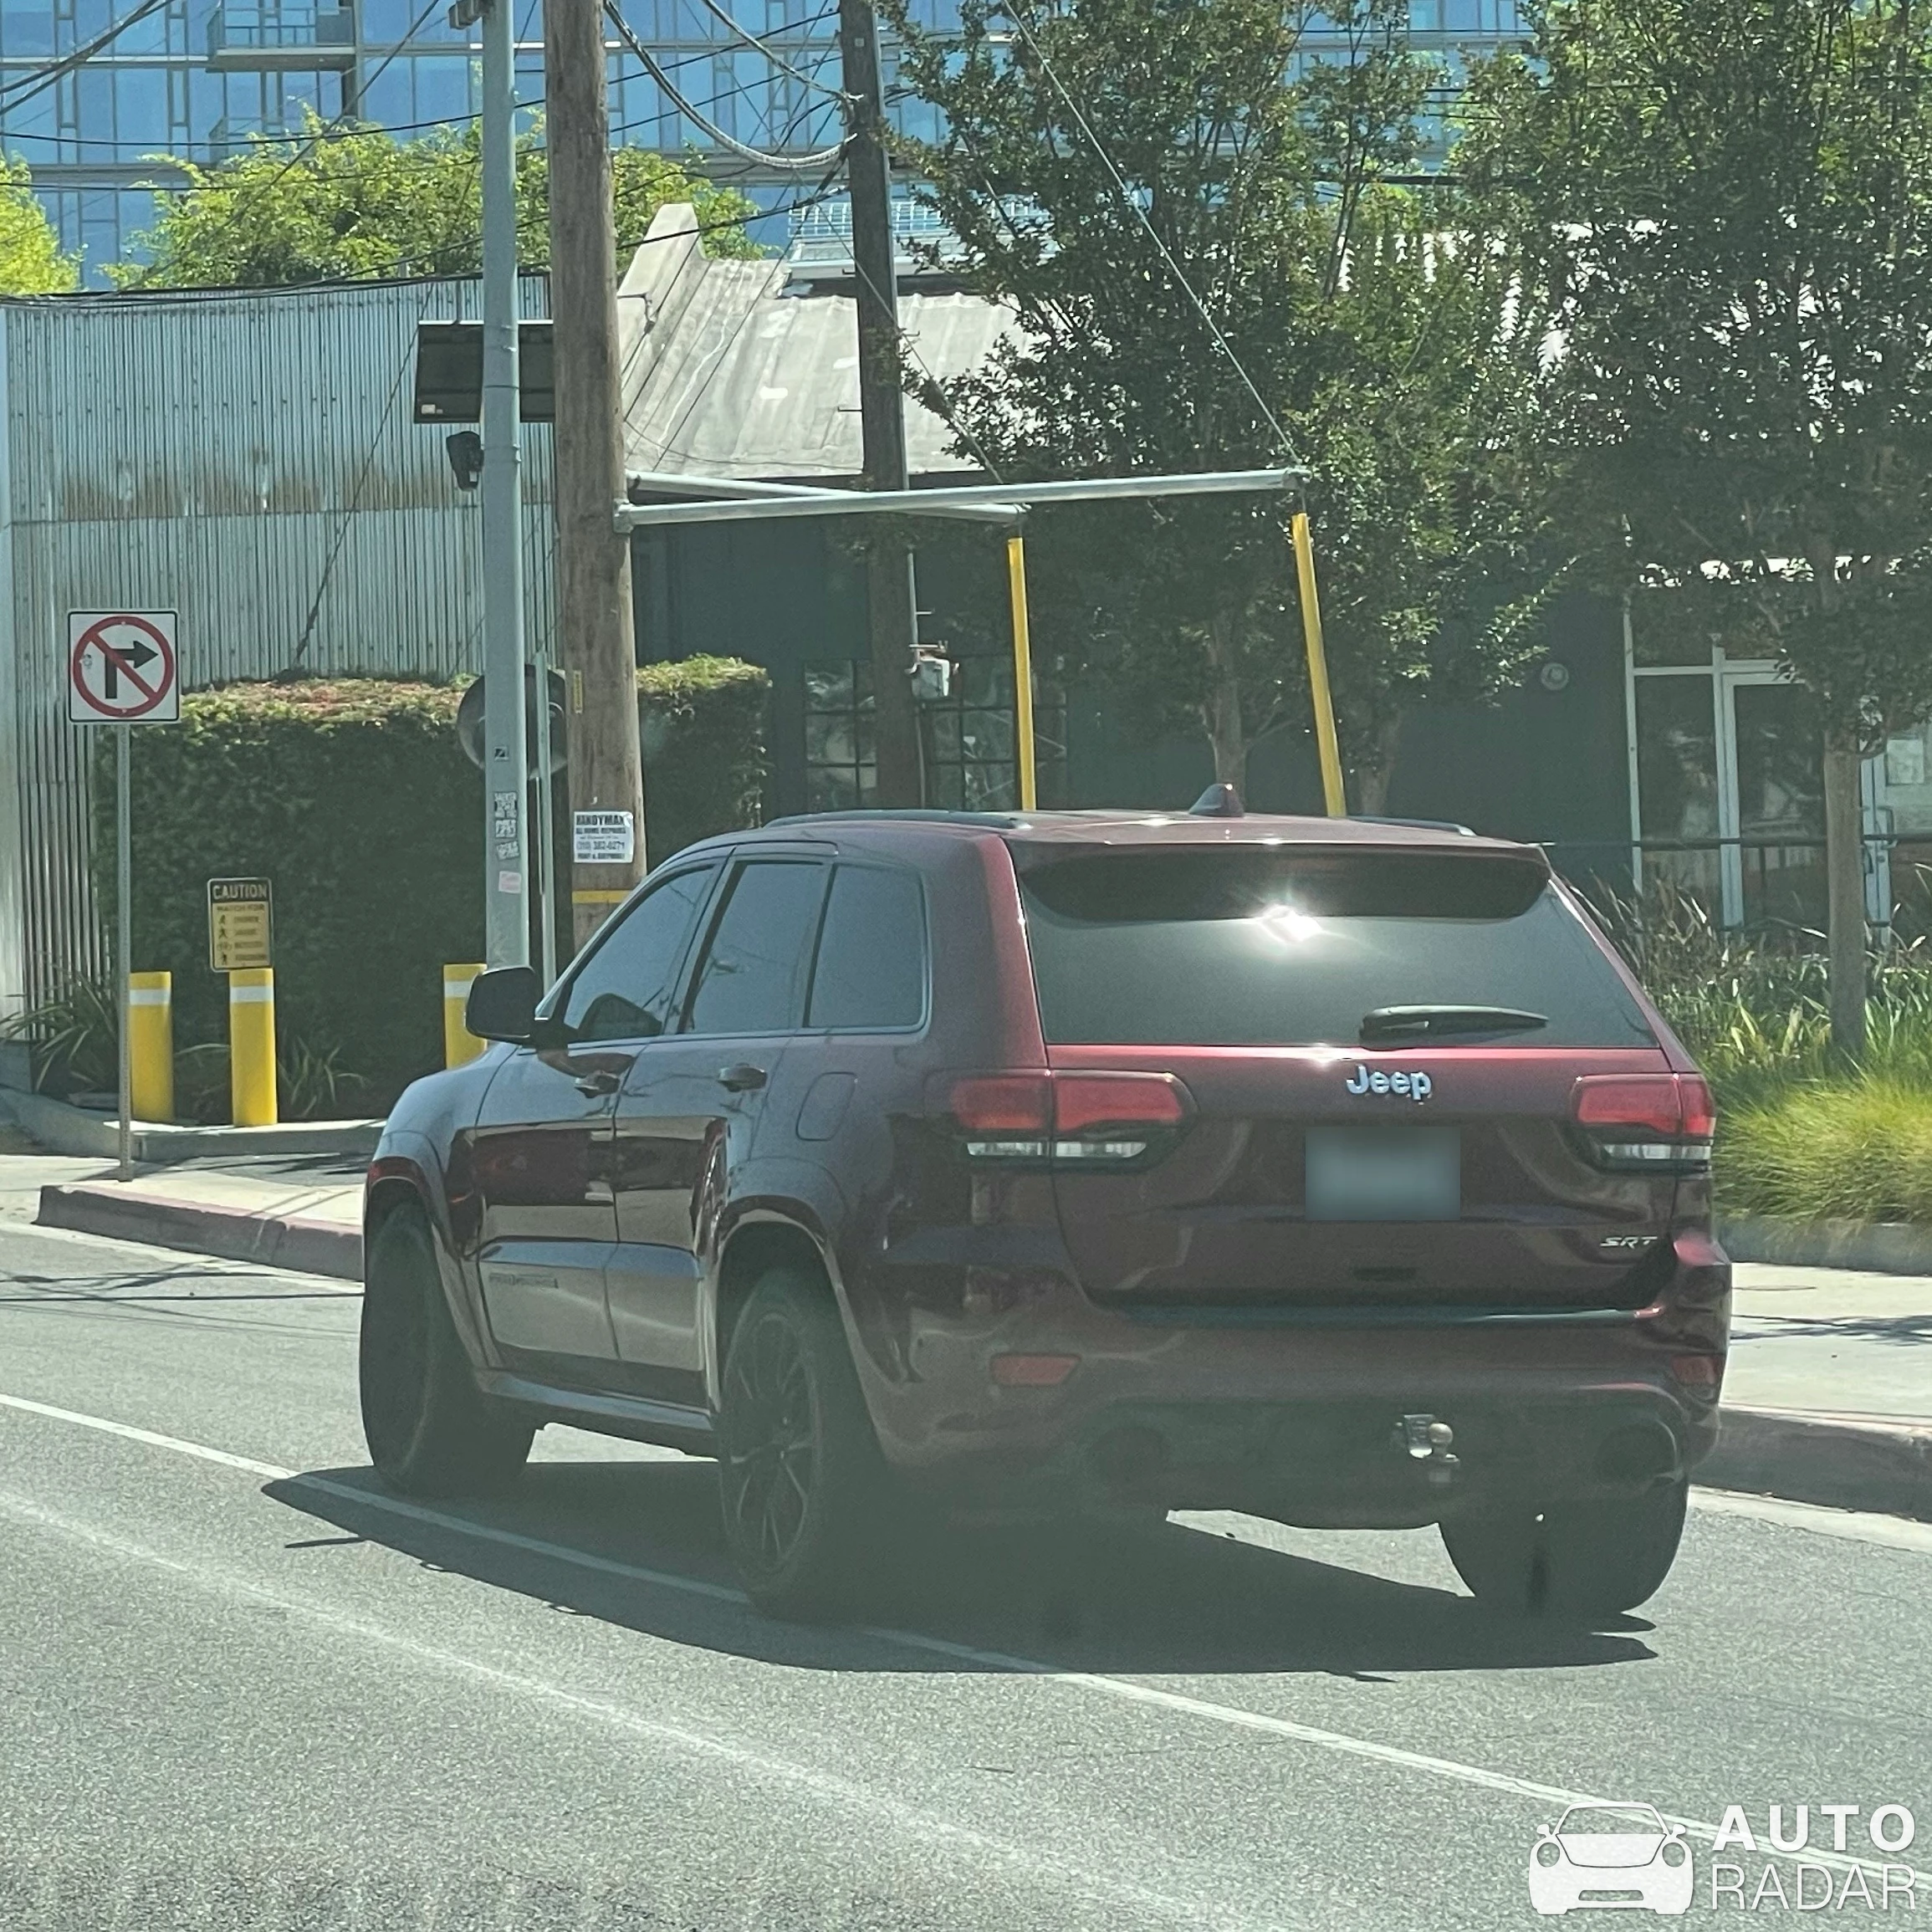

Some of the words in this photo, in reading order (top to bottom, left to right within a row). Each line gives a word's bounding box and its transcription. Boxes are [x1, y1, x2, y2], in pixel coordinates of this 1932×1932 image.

[212, 884, 267, 900] CAUTION
[1346, 1064, 1432, 1101] Jeep
[1600, 1236, 1658, 1249] SRT
